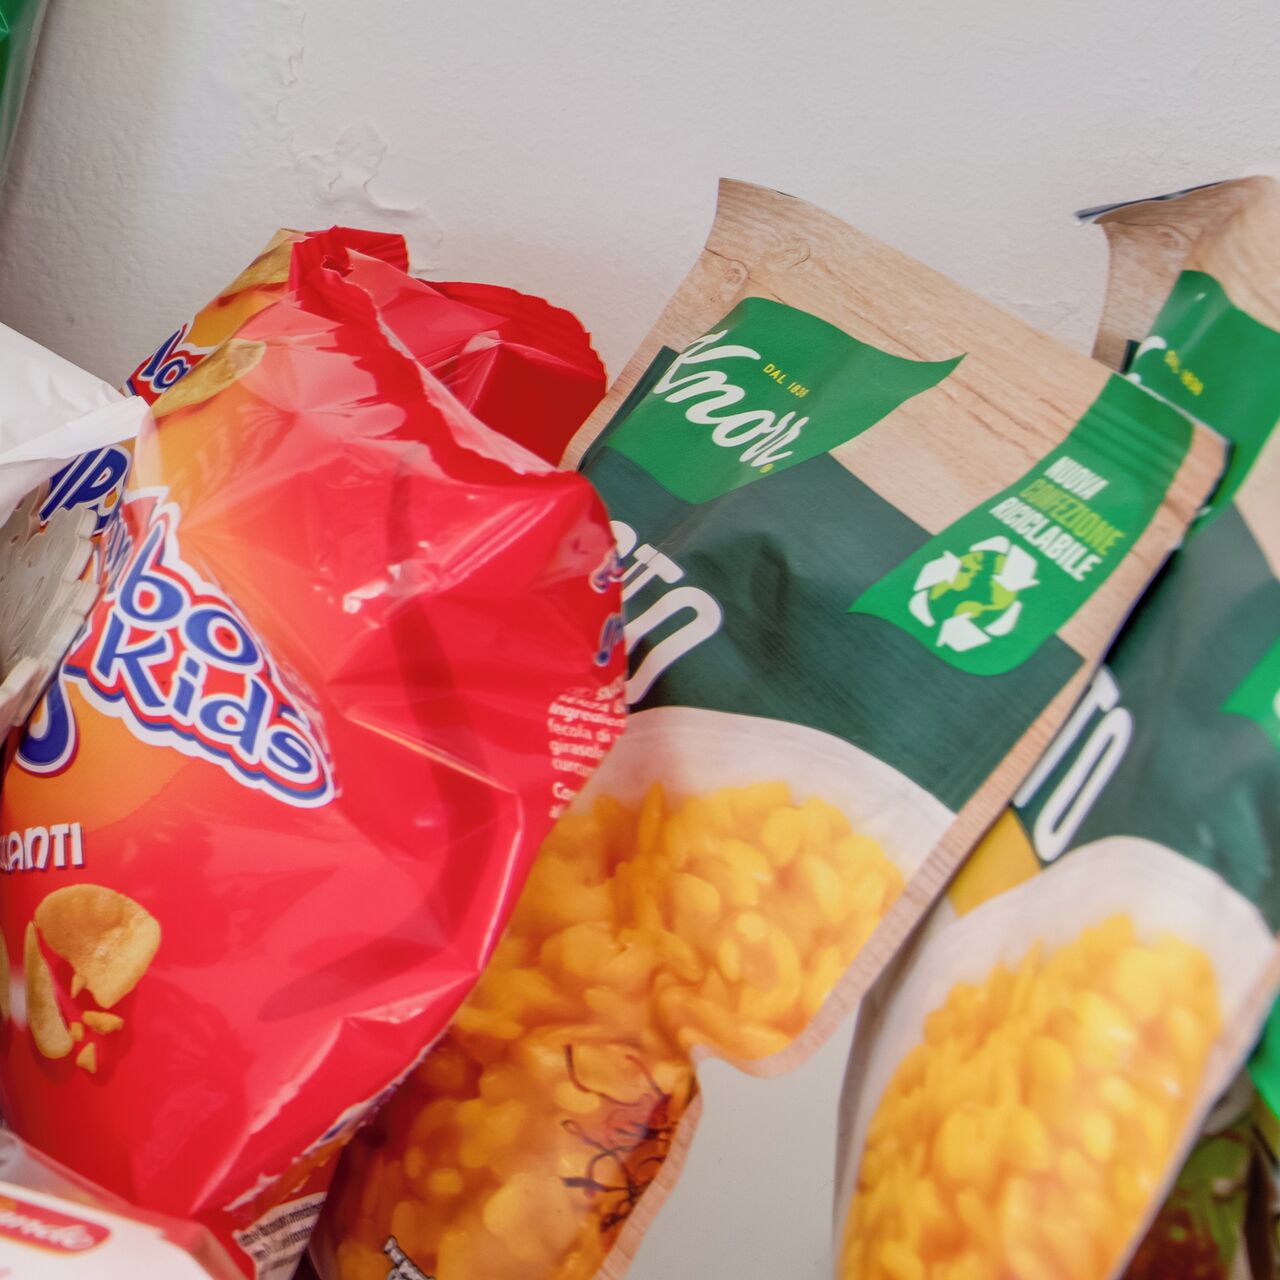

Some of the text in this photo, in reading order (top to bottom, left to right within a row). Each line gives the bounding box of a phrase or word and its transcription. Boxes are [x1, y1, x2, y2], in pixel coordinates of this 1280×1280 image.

[653, 329, 810, 468] Knorr
[762, 363, 788, 385] DAL
[1018, 478, 1126, 557] CONFEZIONE
[1043, 455, 1110, 501] NUOVA
[988, 496, 1103, 582] RICICLABILE
[95, 610, 313, 775] Kids
